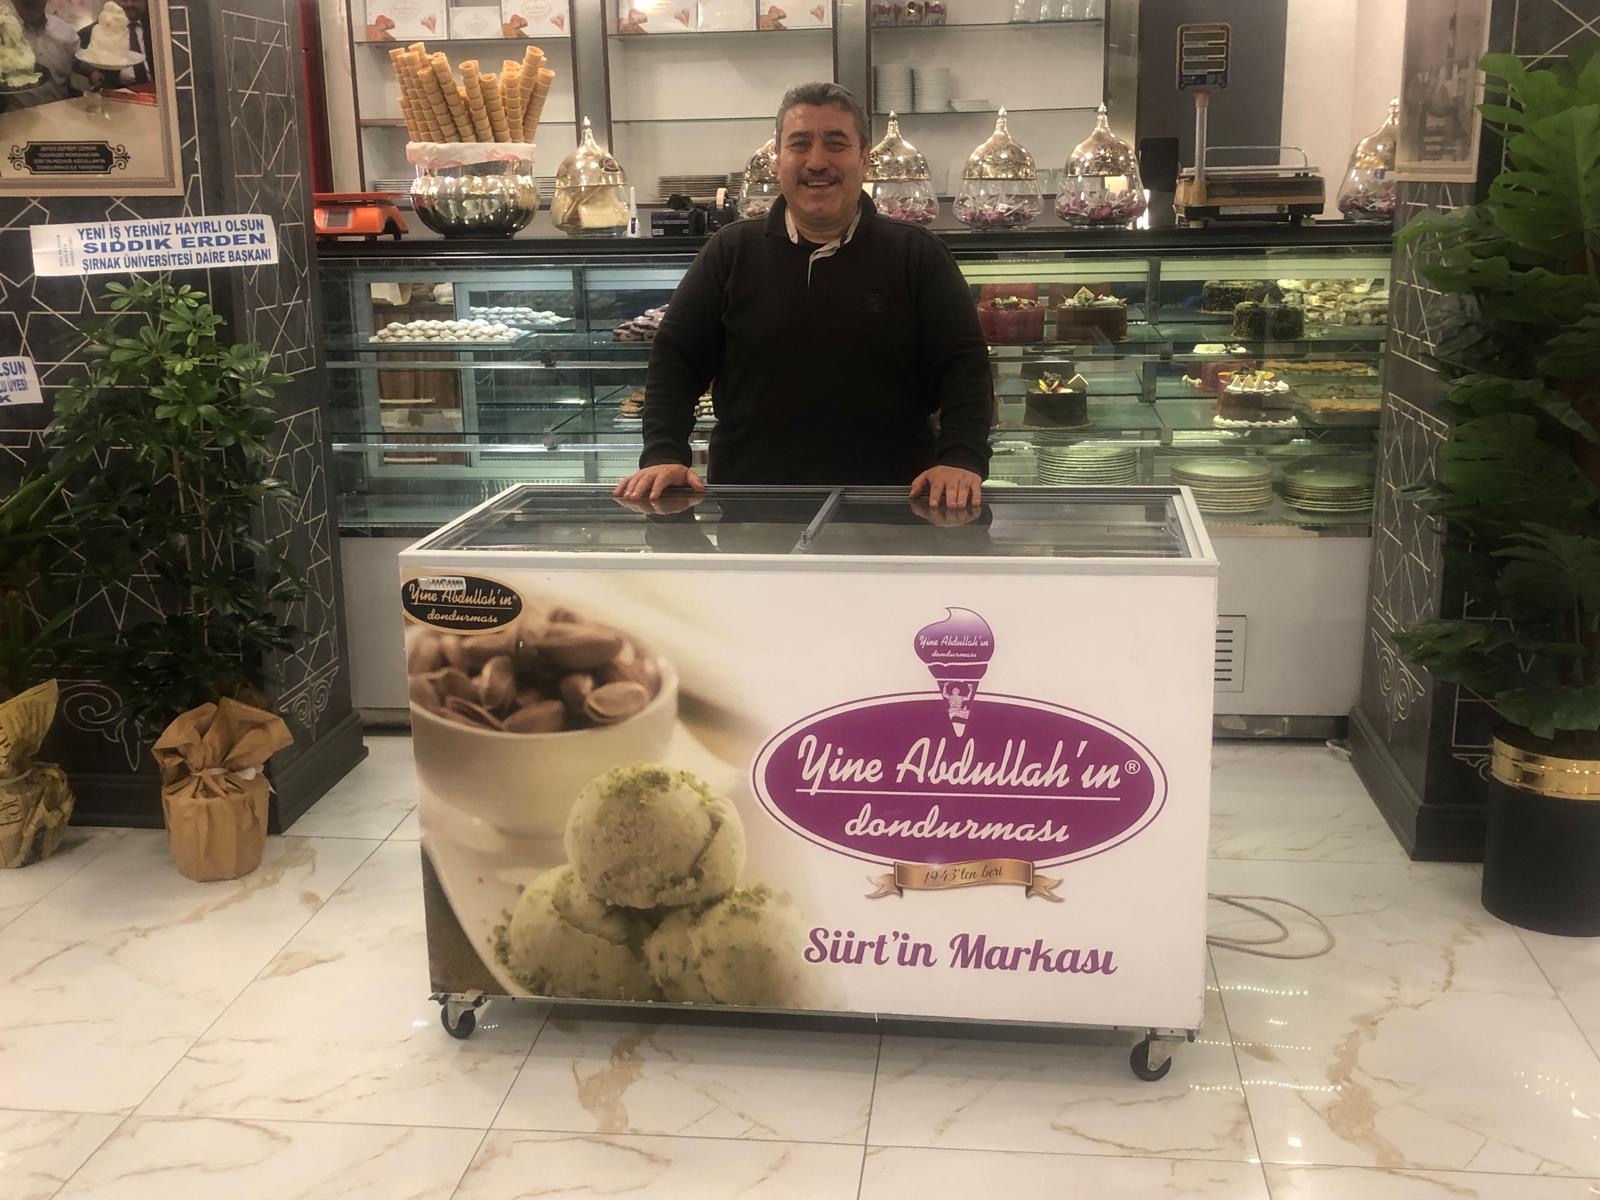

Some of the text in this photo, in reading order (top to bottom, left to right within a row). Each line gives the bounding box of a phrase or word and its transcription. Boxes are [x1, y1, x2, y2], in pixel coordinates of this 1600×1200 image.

[78, 224, 106, 241] YENİ
[124, 220, 172, 238] YERİNİZ
[175, 220, 222, 235] HAYIRLI
[225, 219, 265, 232] OLSUN
[83, 239, 172, 253] SIDDIK
[181, 233, 266, 248] ERDEN
[124, 250, 193, 269] ÜNİVERSİTESİ
[196, 249, 226, 265] DAİRE
[228, 248, 272, 264] BAŞKANI
[409, 583, 438, 605] Yine
[427, 608, 498, 623] dondurması
[919, 635, 939, 649] Yine
[798, 734, 884, 796] Yine
[844, 802, 1070, 843] dondurması
[949, 933, 1118, 975] Markası
